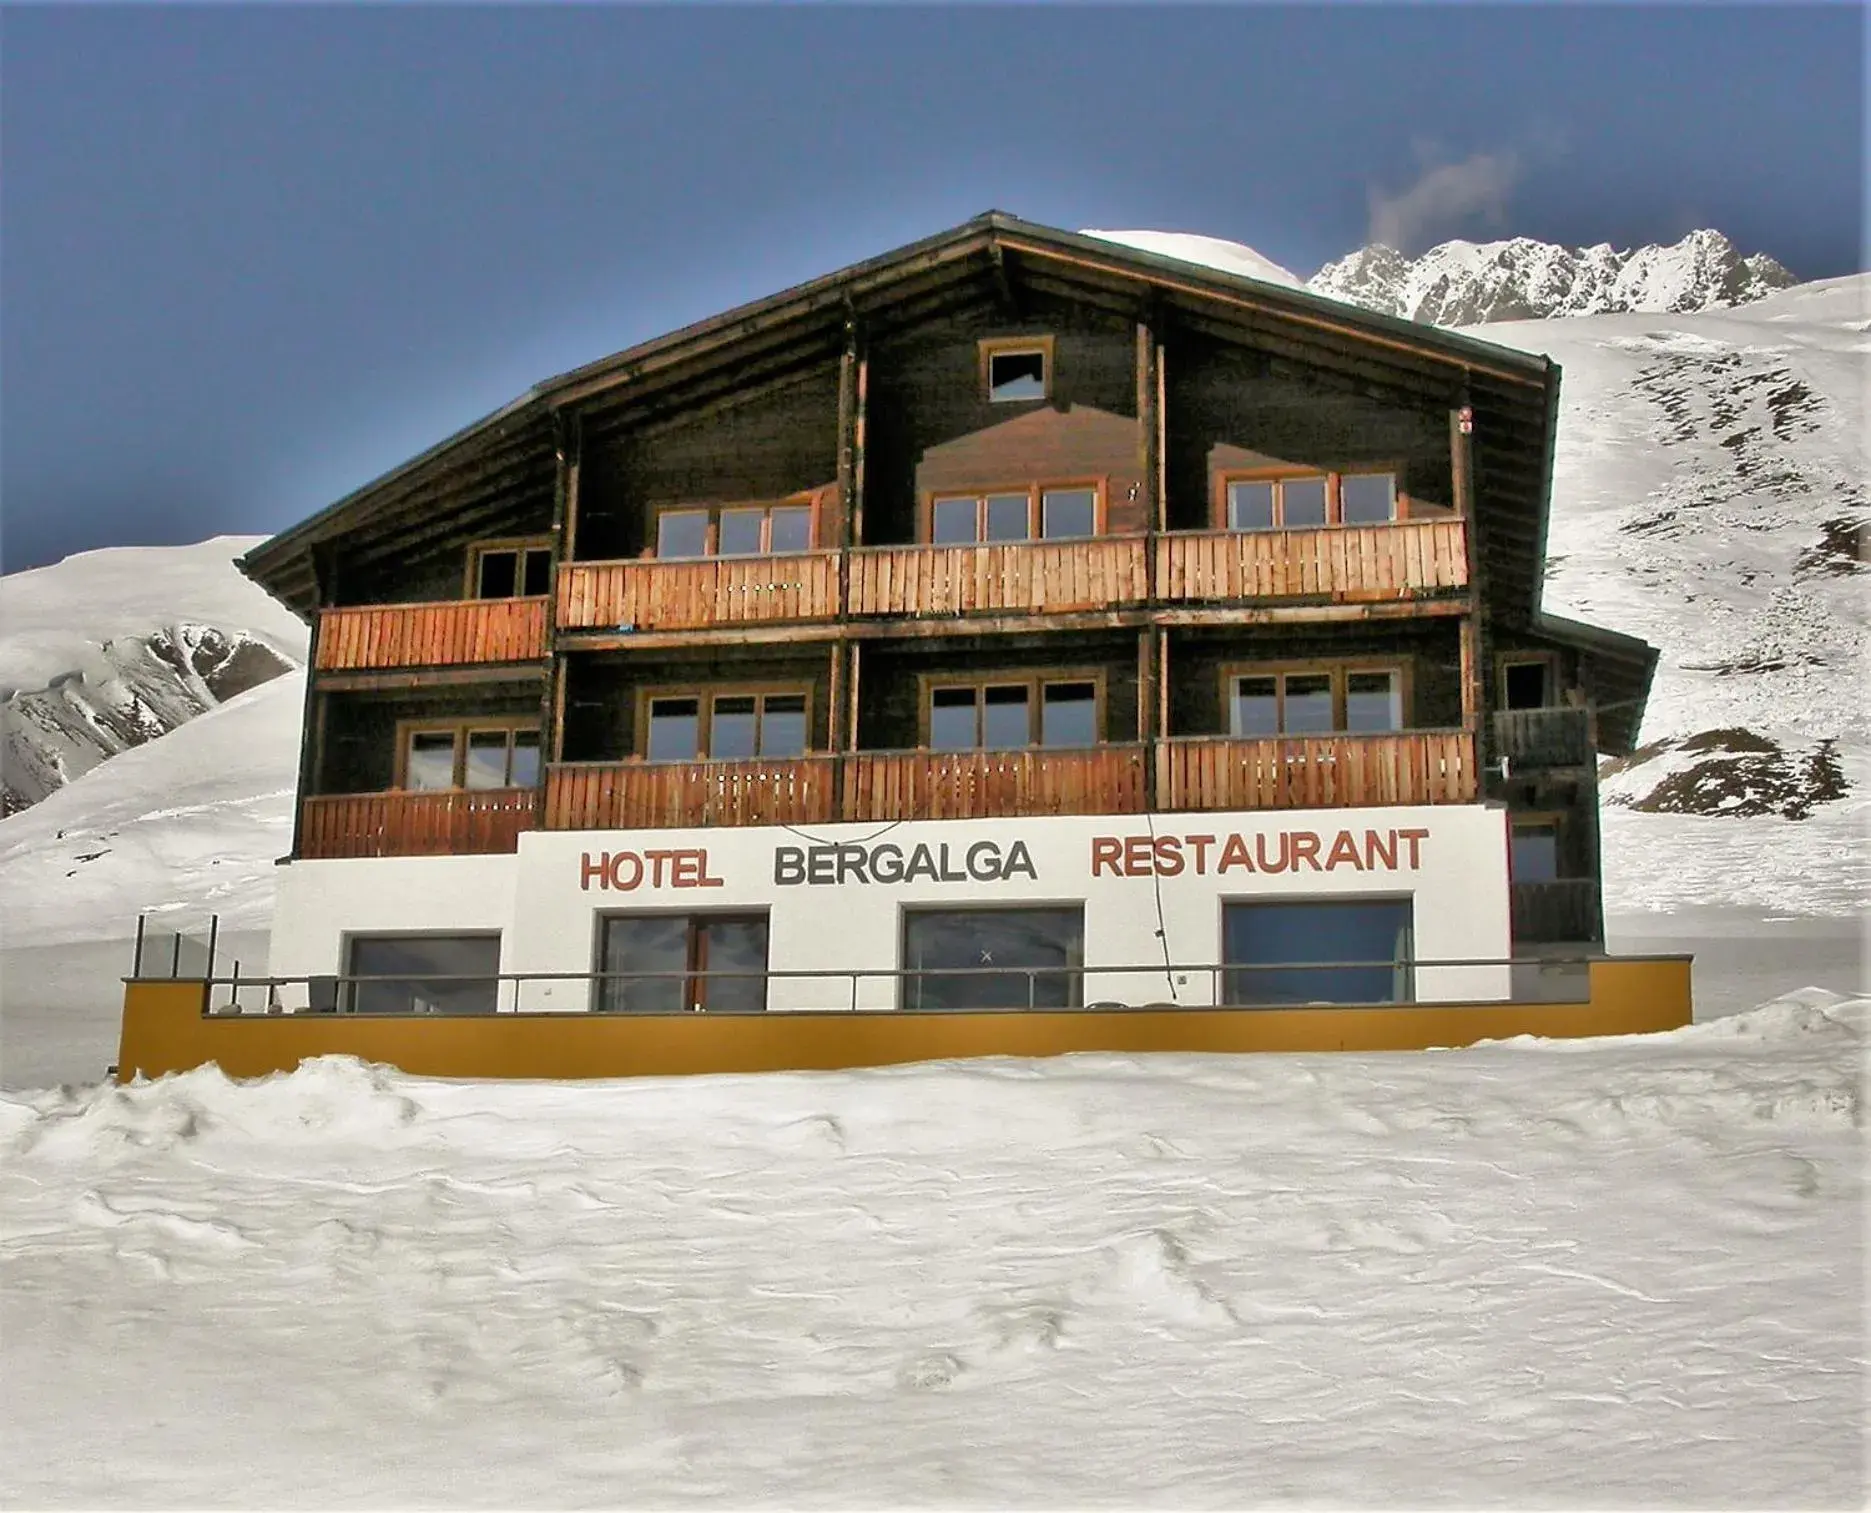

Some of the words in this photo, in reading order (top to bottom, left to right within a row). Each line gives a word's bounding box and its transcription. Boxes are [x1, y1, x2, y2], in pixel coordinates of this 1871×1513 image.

[581, 849, 724, 891] HOTEL
[774, 841, 1038, 886] BERGALGA
[1092, 828, 1430, 877] RESTAURANT
